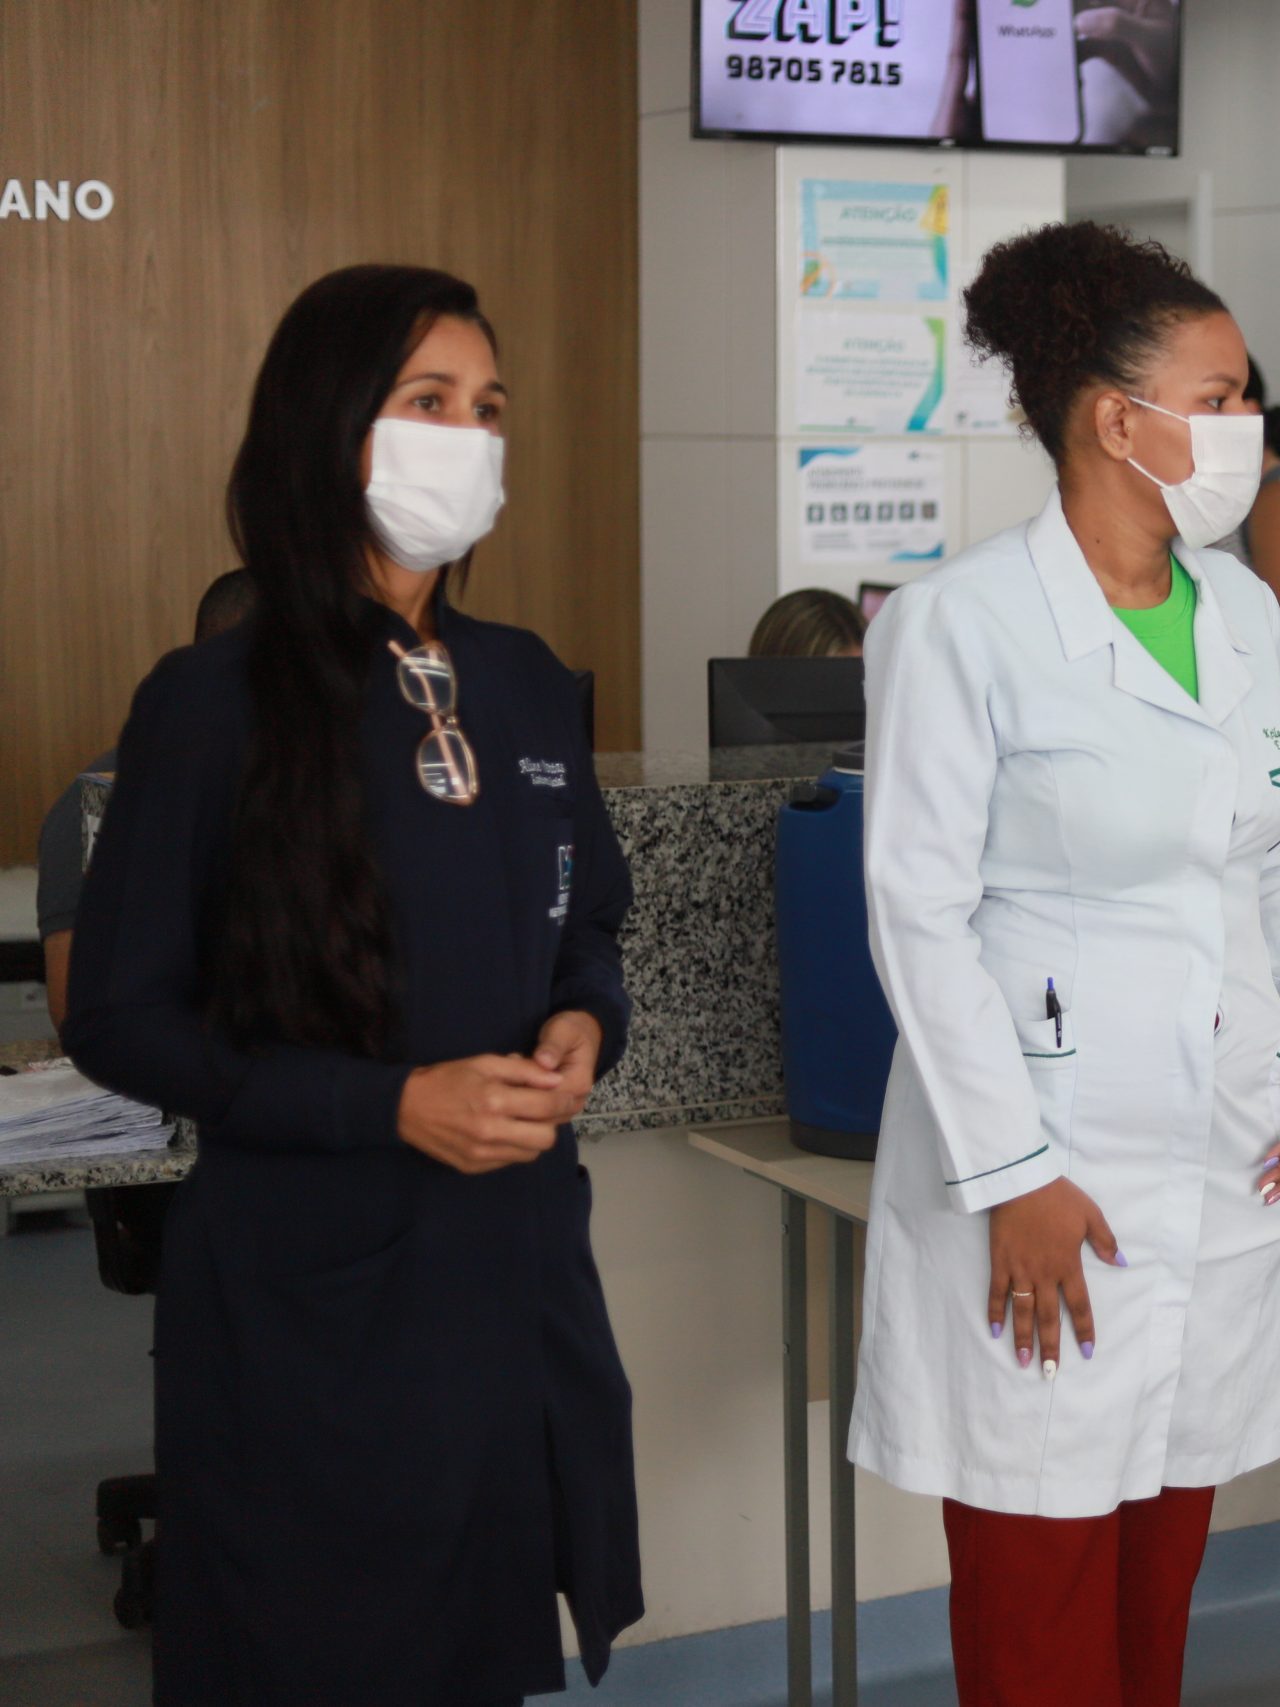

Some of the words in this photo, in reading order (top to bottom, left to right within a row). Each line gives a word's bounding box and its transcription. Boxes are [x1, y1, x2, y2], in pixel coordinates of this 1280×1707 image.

[727, 0, 900, 47] ZAP!
[727, 55, 822, 82] 98705
[832, 60, 901, 86] 7815
[0, 179, 114, 221] ANO
